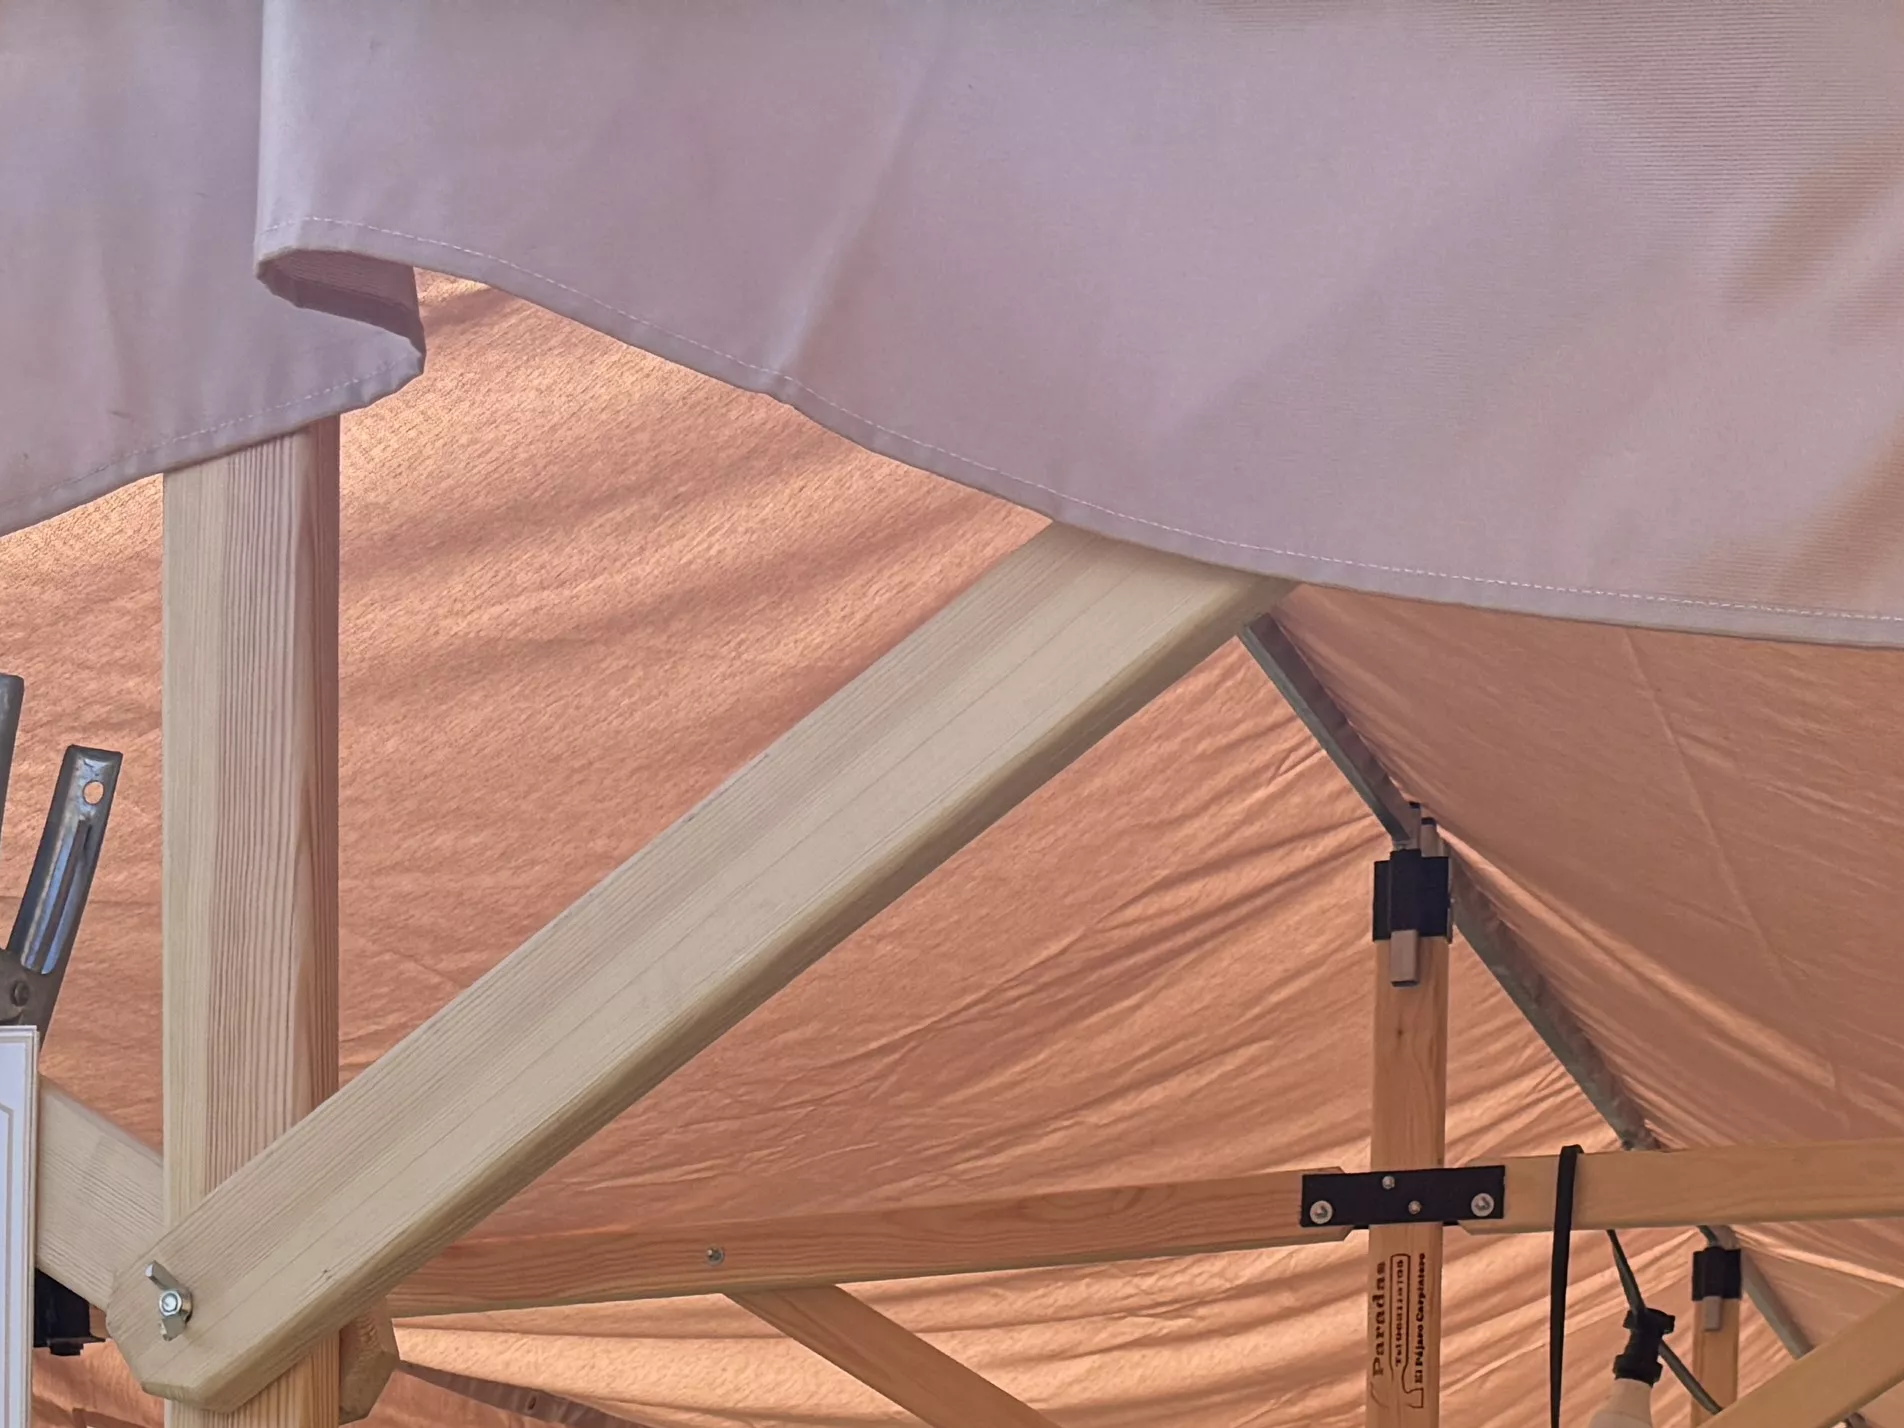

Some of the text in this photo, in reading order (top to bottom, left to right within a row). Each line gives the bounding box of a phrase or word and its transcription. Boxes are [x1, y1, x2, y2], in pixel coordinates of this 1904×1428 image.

[1371, 1261, 1386, 1377] Paradas
[1414, 1252, 1427, 1322] Carpintero
[1414, 1370, 1425, 1384] El
